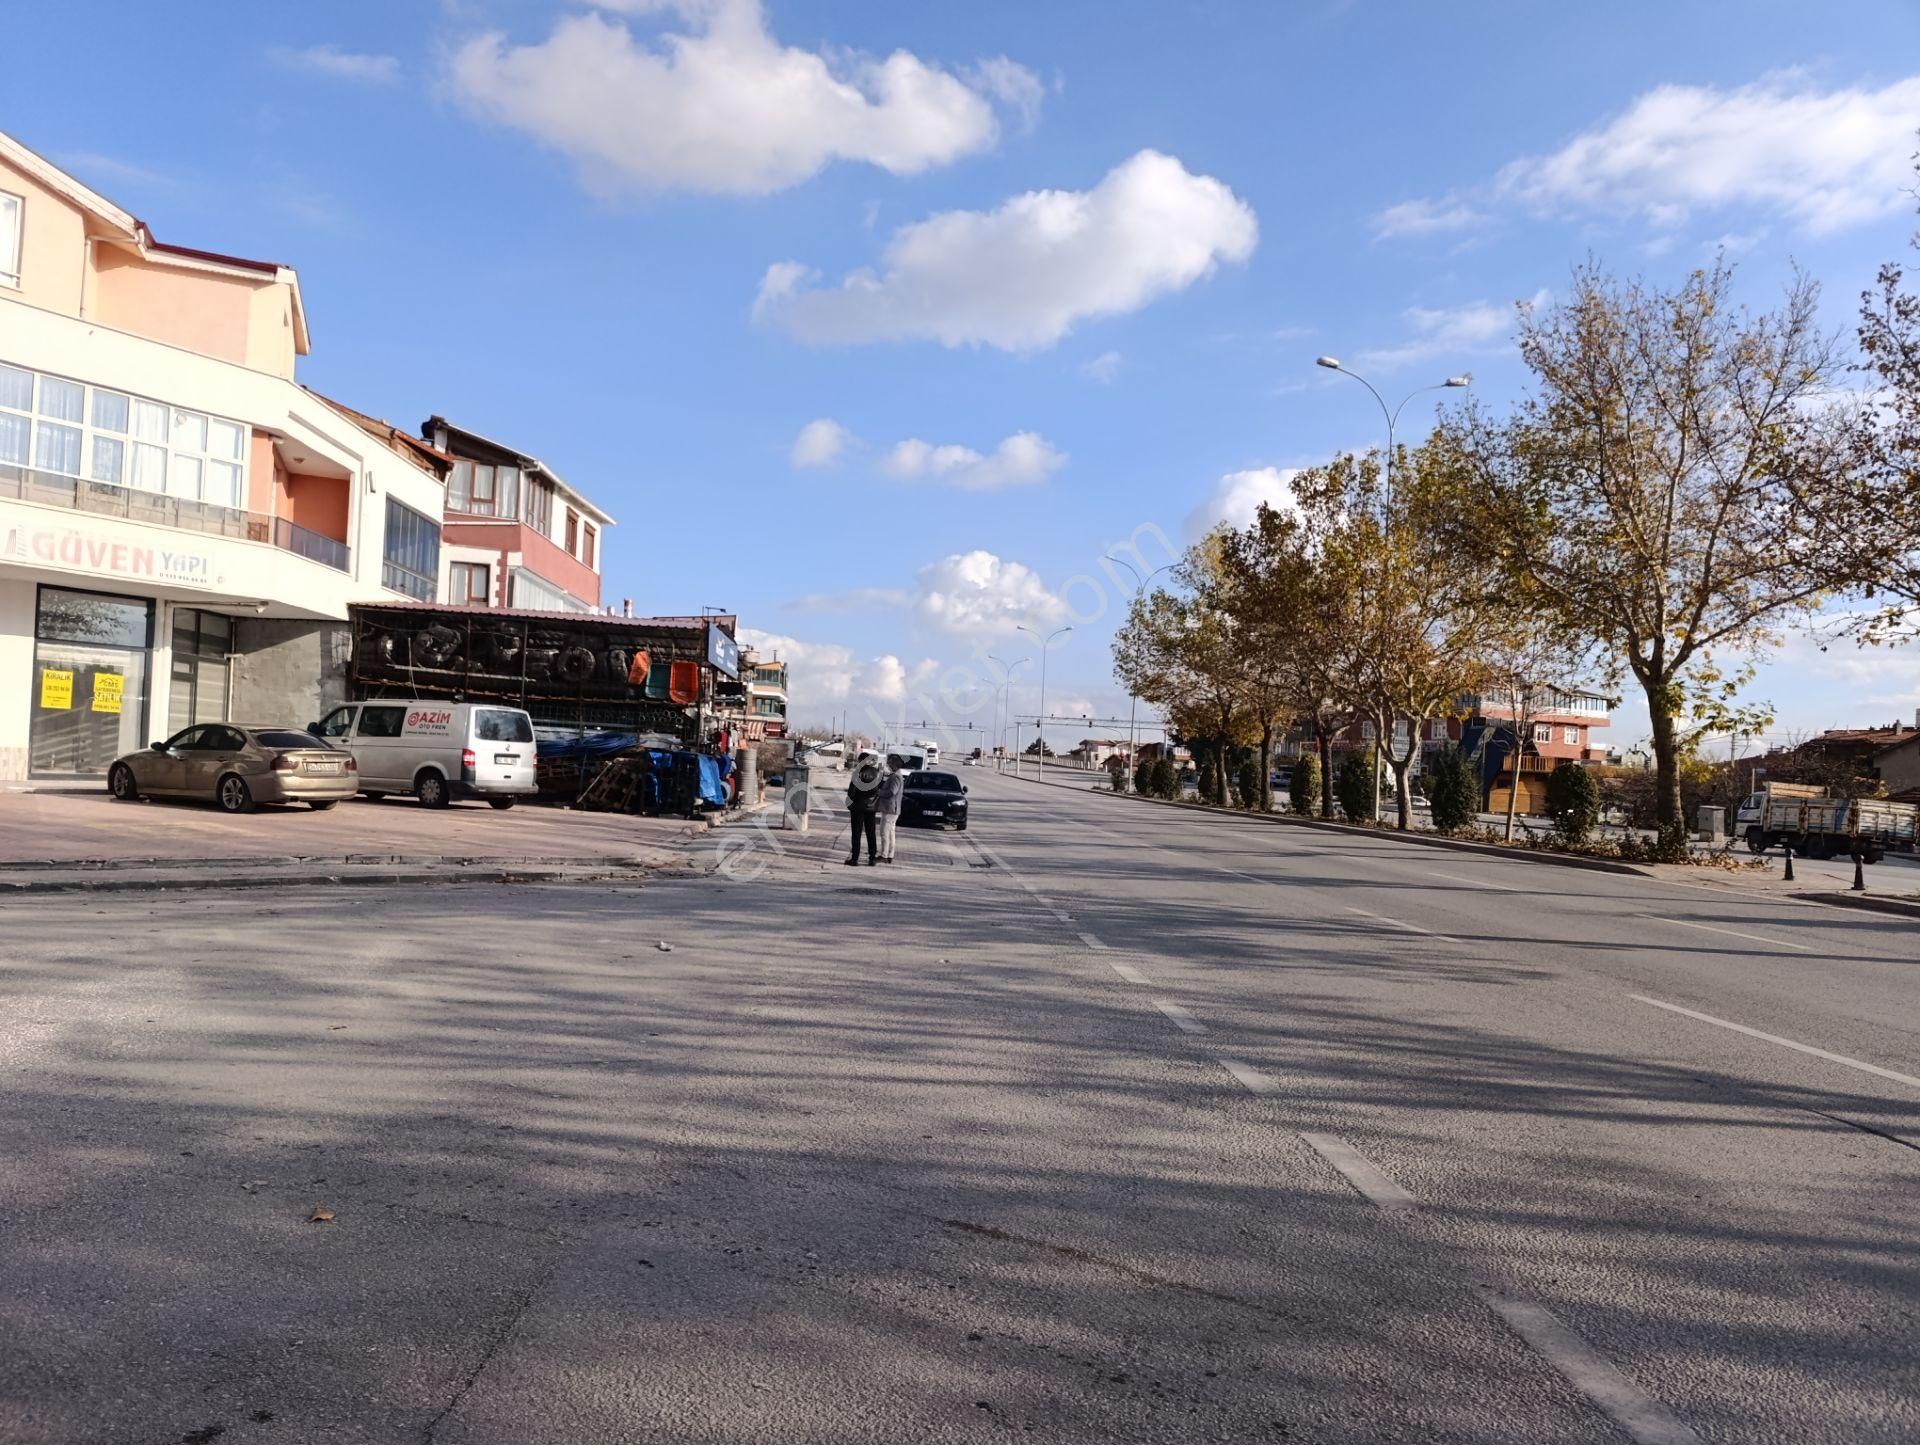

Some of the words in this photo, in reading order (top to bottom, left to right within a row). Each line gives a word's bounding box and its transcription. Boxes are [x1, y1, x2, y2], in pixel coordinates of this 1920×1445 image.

[32, 530, 154, 576] GÜVEN
[161, 552, 207, 574] YAPI
[418, 710, 451, 724] AZİM
